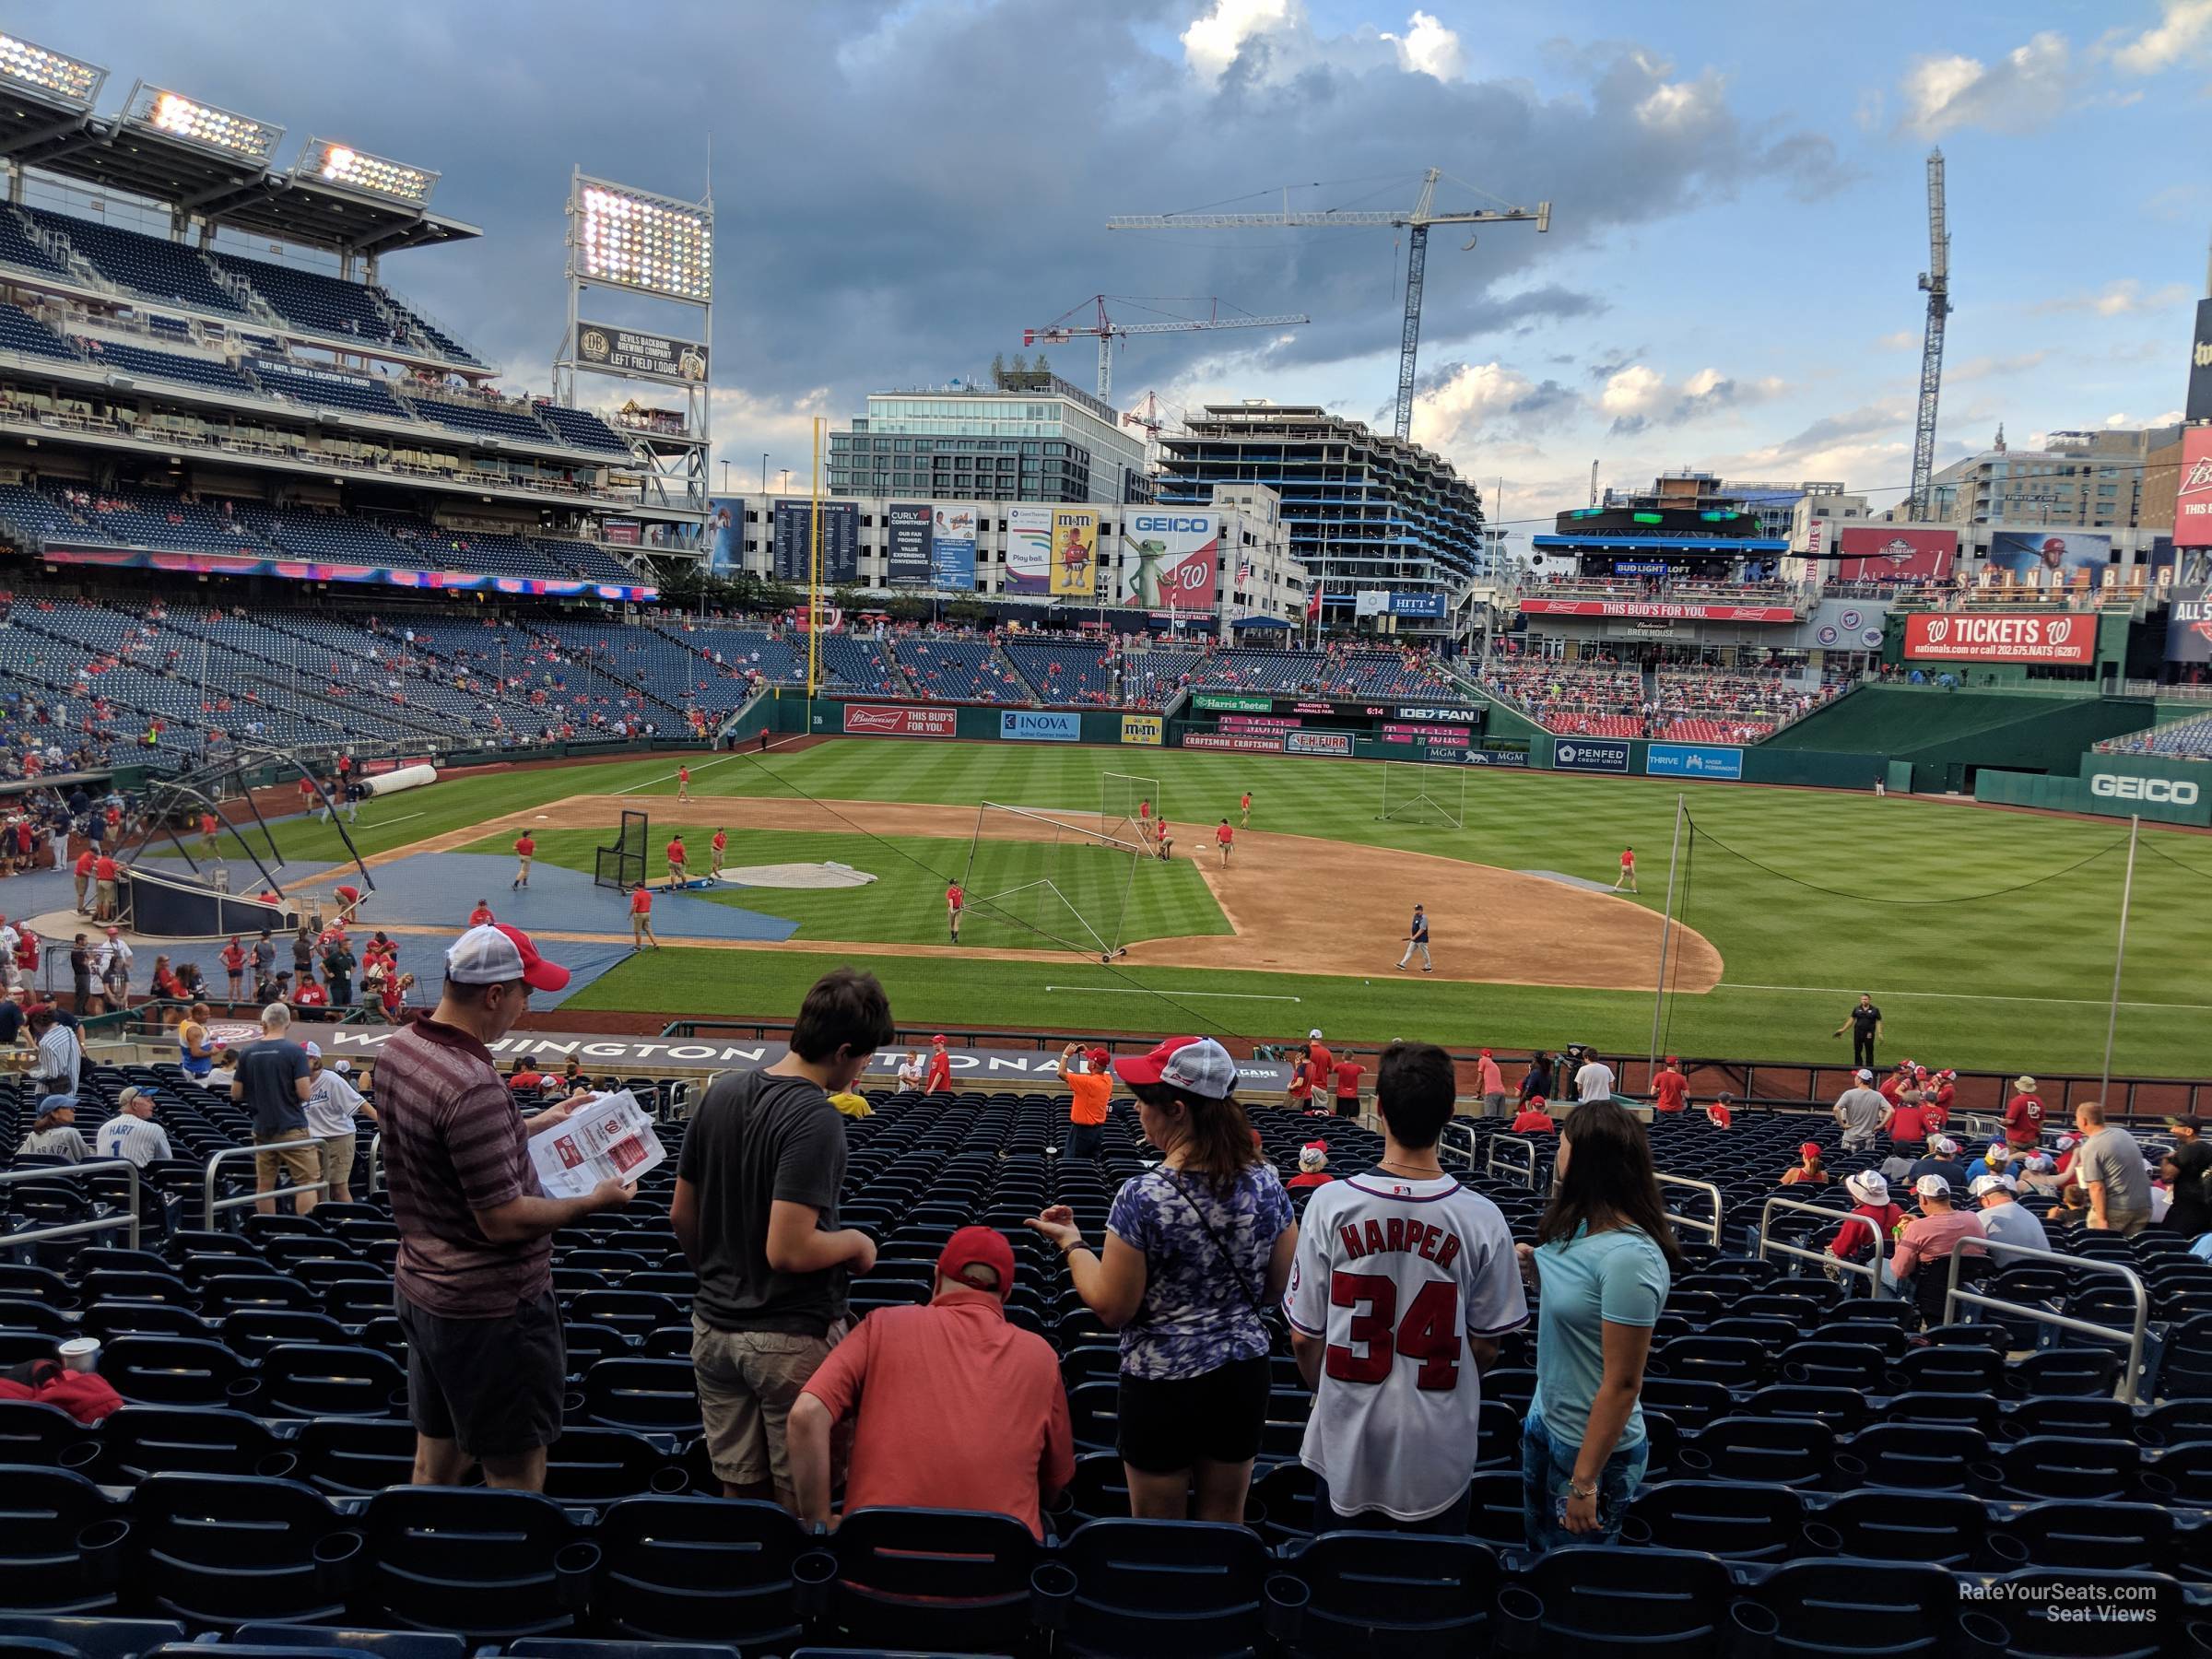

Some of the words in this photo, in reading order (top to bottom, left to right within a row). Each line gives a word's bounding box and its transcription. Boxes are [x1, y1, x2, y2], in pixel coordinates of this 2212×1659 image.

[619, 333, 639, 345] DEVILS
[641, 336, 671, 350] BACKBONE
[618, 341, 644, 354] BREWING
[645, 346, 671, 359] COMPANY
[611, 353, 629, 366] LEFT
[631, 356, 652, 370] FIELD
[654, 360, 678, 375] LODGE
[259, 360, 272, 369] TEXT
[273, 363, 289, 373] NATS,
[291, 366, 307, 377] ISSUE
[314, 371, 341, 382] LOCATION
[343, 375, 351, 384] TO
[2185, 504, 2206, 515] THIS
[1135, 517, 1208, 533] GEICO
[1012, 554, 1028, 563] Play
[1180, 562, 1208, 590] W
[1957, 571, 2065, 588] SWING
[2103, 569, 2171, 587] BIG
[1397, 600, 1426, 608] HITT
[1602, 603, 1626, 614] THIS
[1628, 604, 1659, 615] BUD'S
[1661, 605, 1682, 616] FOR
[1683, 606, 1708, 617] YOU.
[2175, 603, 2201, 620] ALL
[1627, 628, 1647, 636] BREW
[1648, 629, 1674, 637] HOUSE
[1954, 619, 2040, 643] TICKETS
[1915, 643, 1969, 654] nationals.com
[1980, 645, 1996, 655] call
[1997, 646, 2053, 657] 202.675.NATS
[2054, 646, 2081, 658] (6287)
[1207, 698, 1237, 709] Harris
[1239, 700, 1270, 711] Teeter
[907, 711, 927, 721] THIS
[928, 712, 954, 722] BUD'S
[1366, 707, 1383, 716] 6:14
[1400, 708, 1436, 719] 106.7
[1439, 709, 1475, 721] FAN
[813, 716, 823, 724] 336
[852, 713, 897, 724] Budweiser
[1020, 717, 1068, 729] INOVA
[907, 722, 924, 731] FOR
[926, 724, 944, 732] YOU.
[1186, 737, 1230, 747] CRAFTSMAN
[1234, 740, 1280, 749] CRAFTSMAN
[1320, 737, 1346, 747] FURR
[1417, 737, 1426, 746] 377
[1430, 748, 1456, 758] MGM
[1497, 753, 1524, 761] MGM
[1578, 748, 1624, 759] PENFED
[1649, 756, 1678, 765] THRIVE
[2091, 774, 2199, 805] GEICO
[333, 1031, 766, 1061] WHINGTON
[1239, 1068, 1279, 1077] GAME
[2027, 1101, 2040, 1119] DC
[109, 1125, 135, 1136] HART
[1340, 1218, 1461, 1270] HARPER
[1325, 1270, 1462, 1390] 34
